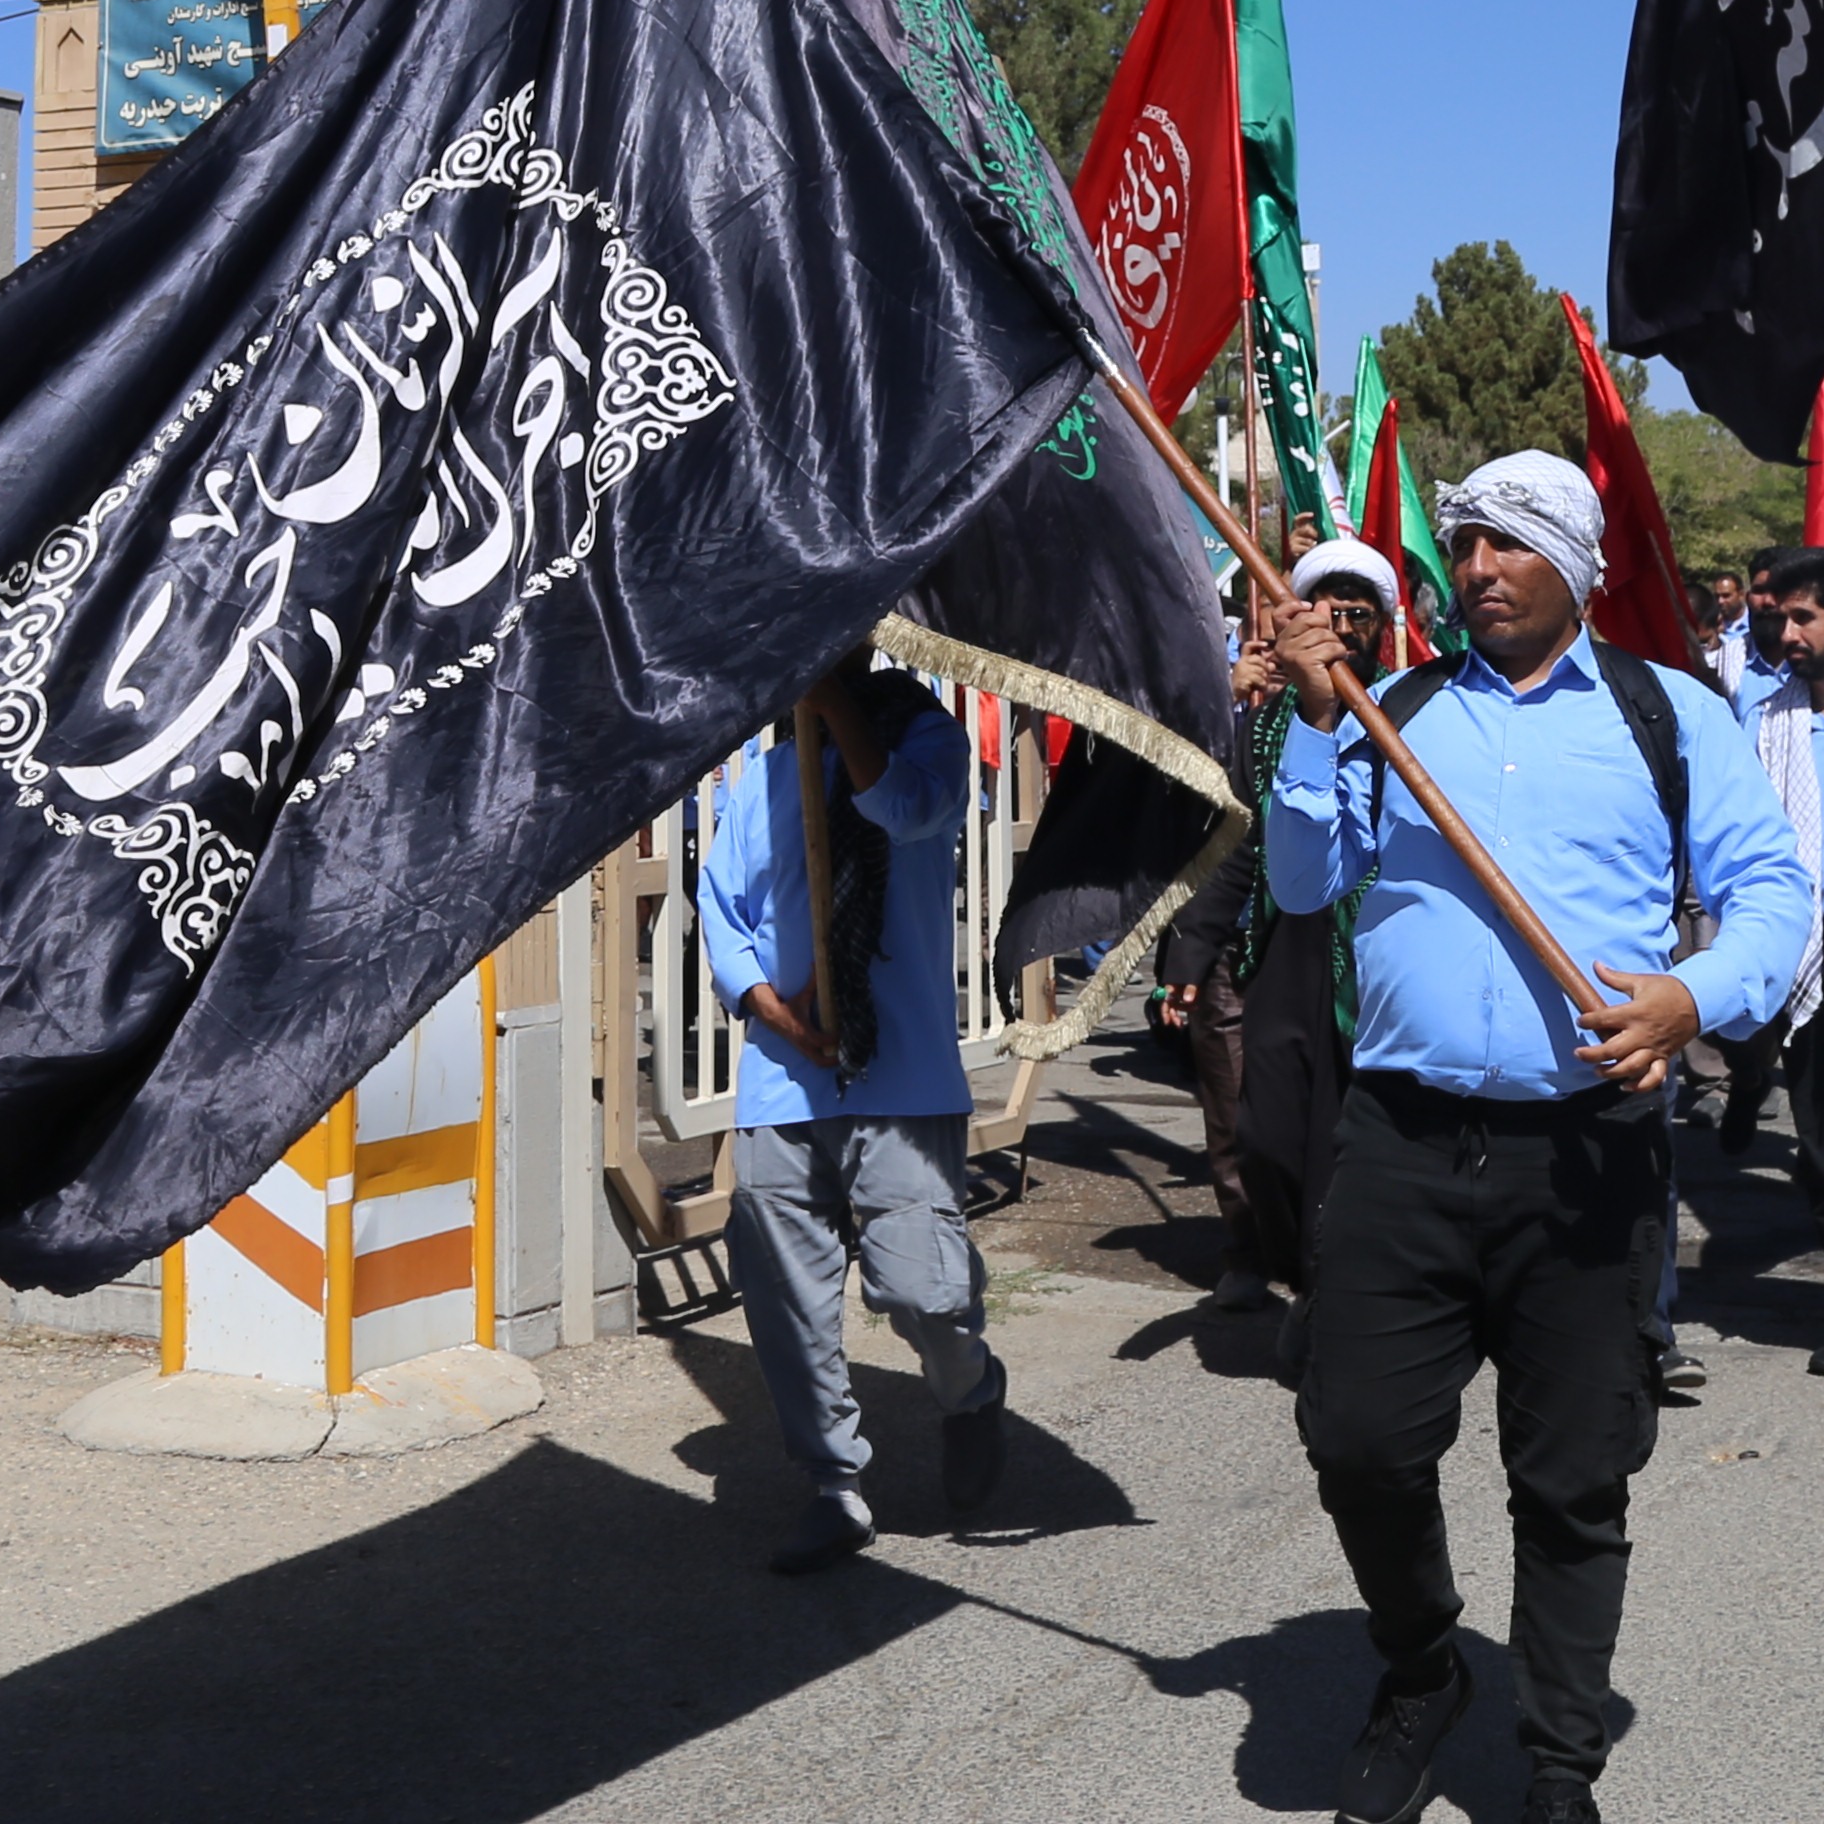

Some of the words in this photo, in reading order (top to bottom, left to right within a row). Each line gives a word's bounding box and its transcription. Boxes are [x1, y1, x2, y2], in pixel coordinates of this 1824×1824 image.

[123, 35, 184, 79] آوینی
[187, 35, 223, 67] شهید
[119, 95, 177, 128] حیدریه
